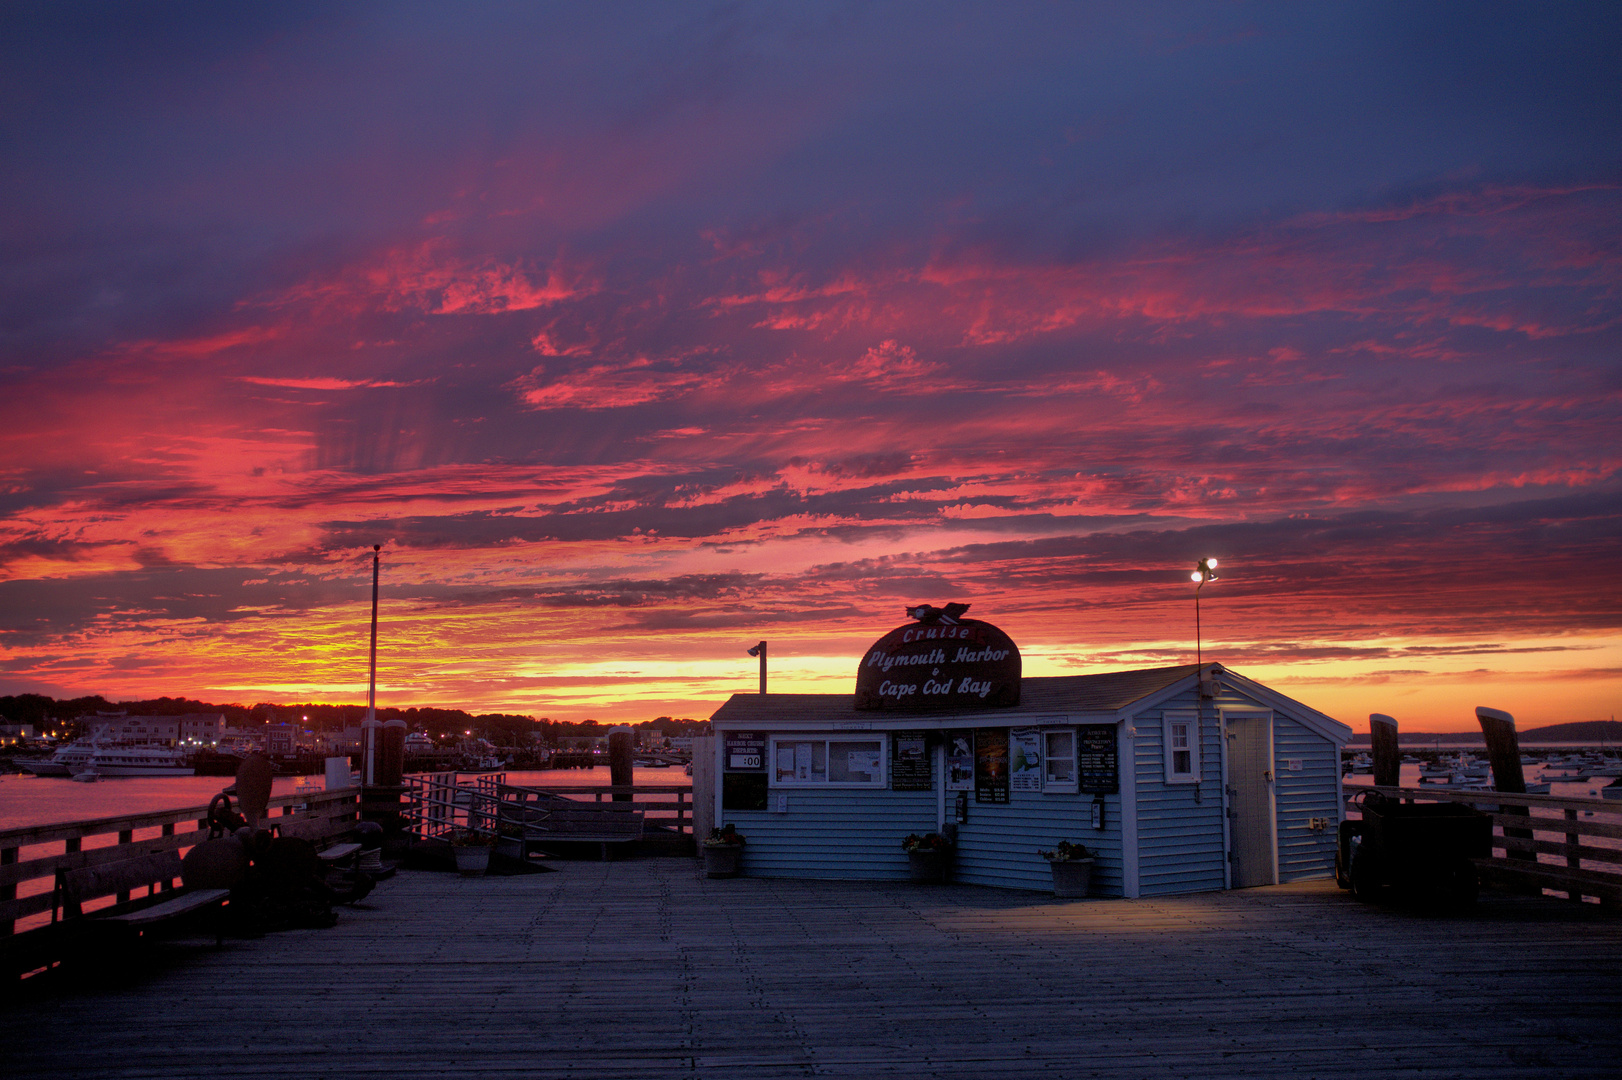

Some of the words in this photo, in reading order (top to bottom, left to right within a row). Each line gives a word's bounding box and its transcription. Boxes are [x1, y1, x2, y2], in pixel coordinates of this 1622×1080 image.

[903, 626, 969, 642] Cruise
[867, 649, 945, 672] Plymouth
[951, 645, 1009, 663] Harbor
[879, 680, 917, 700] Cape
[922, 678, 954, 695] Cod
[957, 676, 992, 698] Bay
[744, 757, 760, 766] :00
